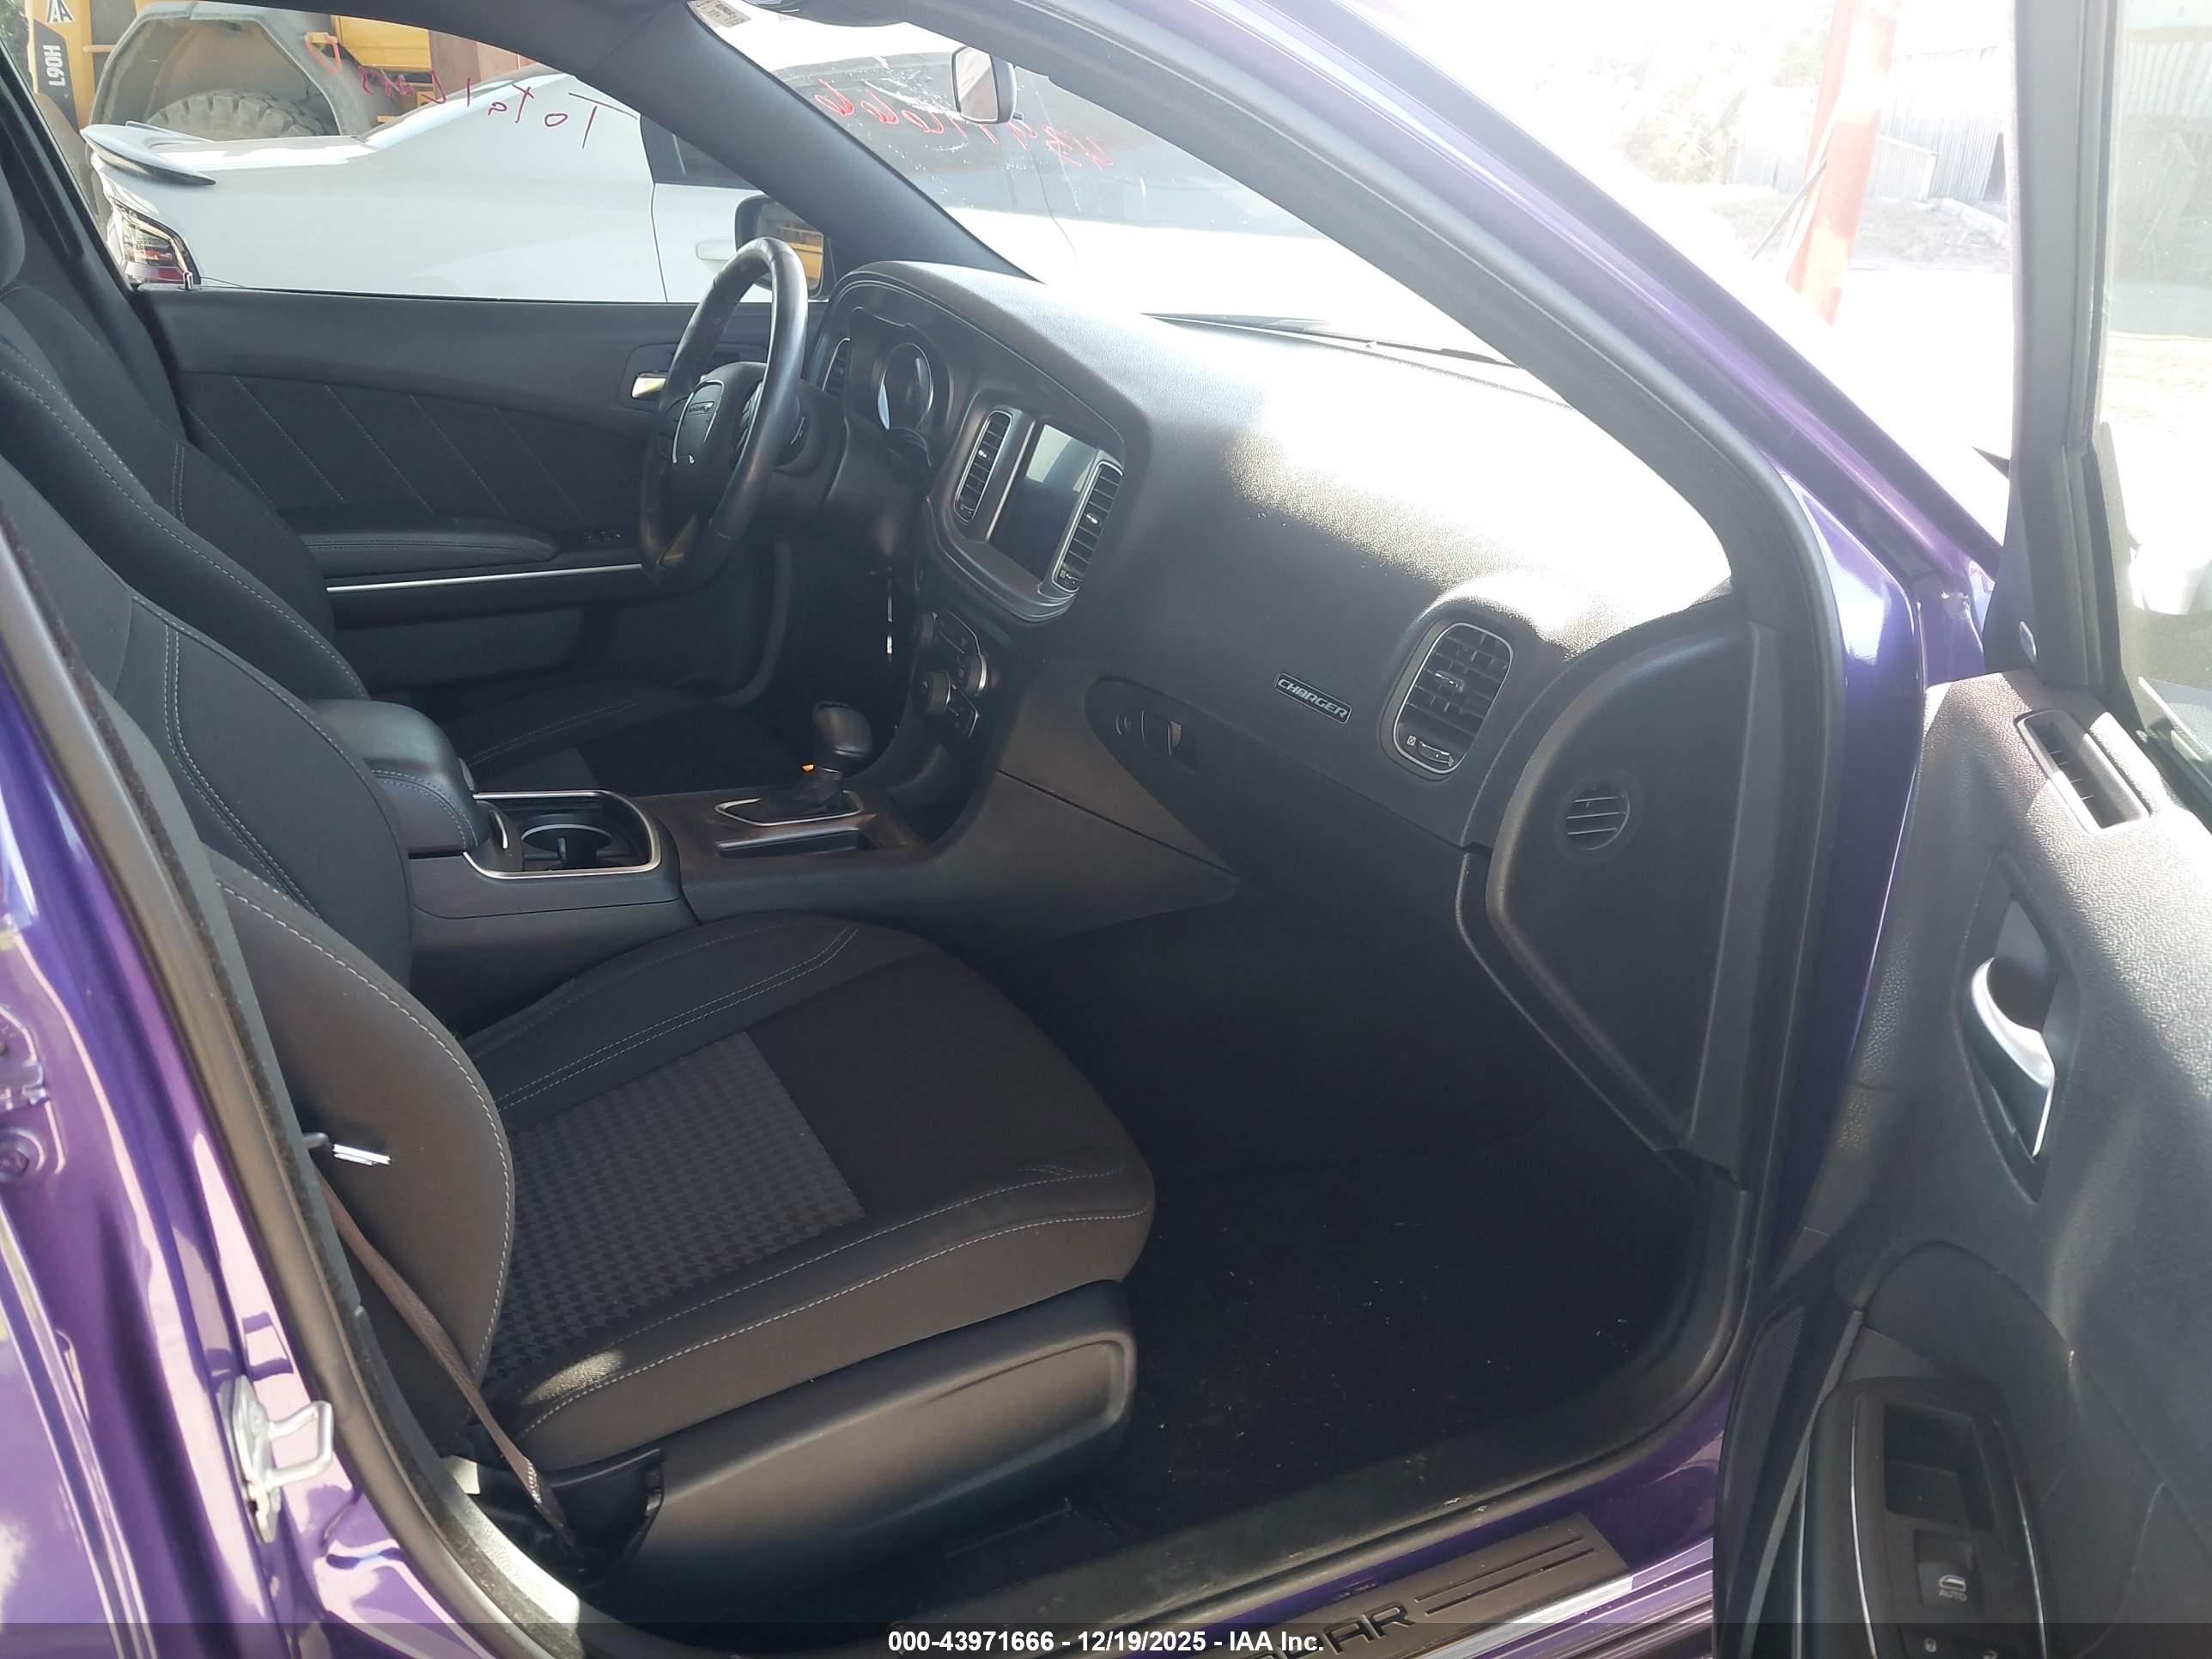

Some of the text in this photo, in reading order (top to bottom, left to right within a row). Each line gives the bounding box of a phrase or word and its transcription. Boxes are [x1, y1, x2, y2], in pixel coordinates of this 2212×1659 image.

[42, 45, 66, 86] L90H
[1277, 678, 1348, 719] CHARGER
[1939, 1589, 1967, 1601] AUTO
